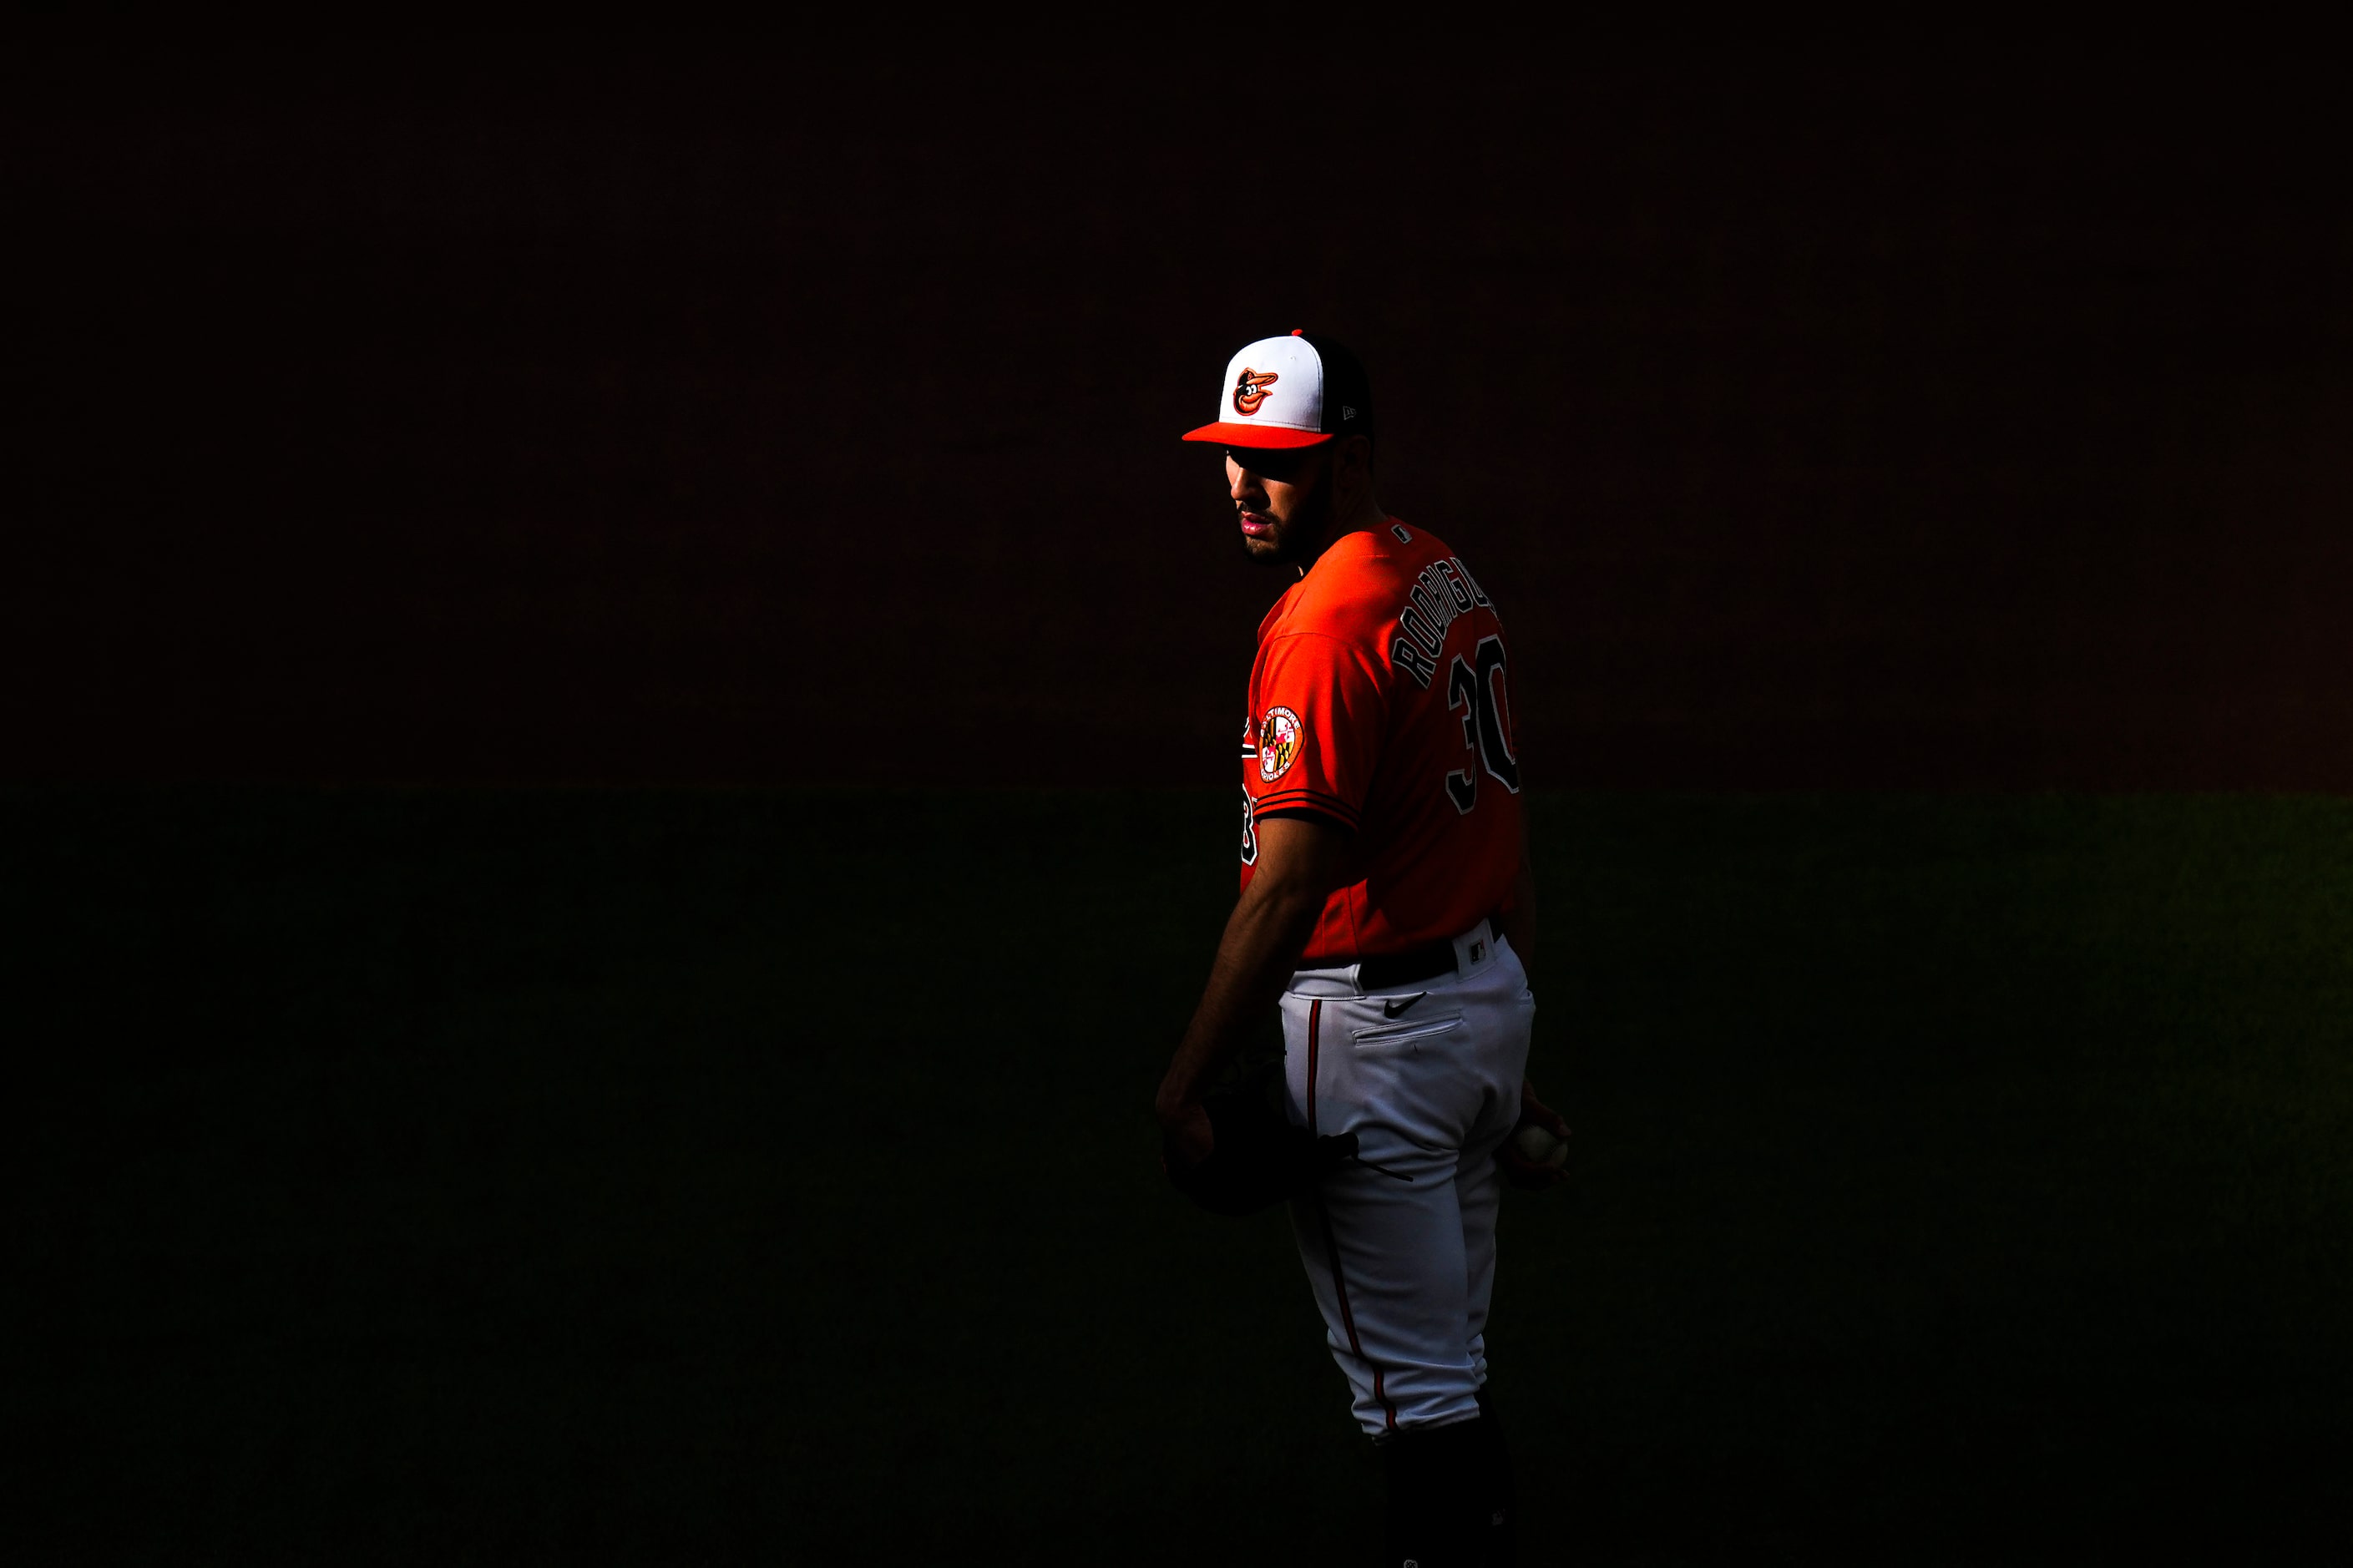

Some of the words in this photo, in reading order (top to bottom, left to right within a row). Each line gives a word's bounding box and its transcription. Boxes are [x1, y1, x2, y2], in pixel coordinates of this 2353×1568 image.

[1391, 557, 1495, 690] RODRIGU
[1260, 706, 1301, 737] BALTIMORE
[1445, 635, 1520, 815] 30
[1261, 761, 1291, 781] ORIOLES
